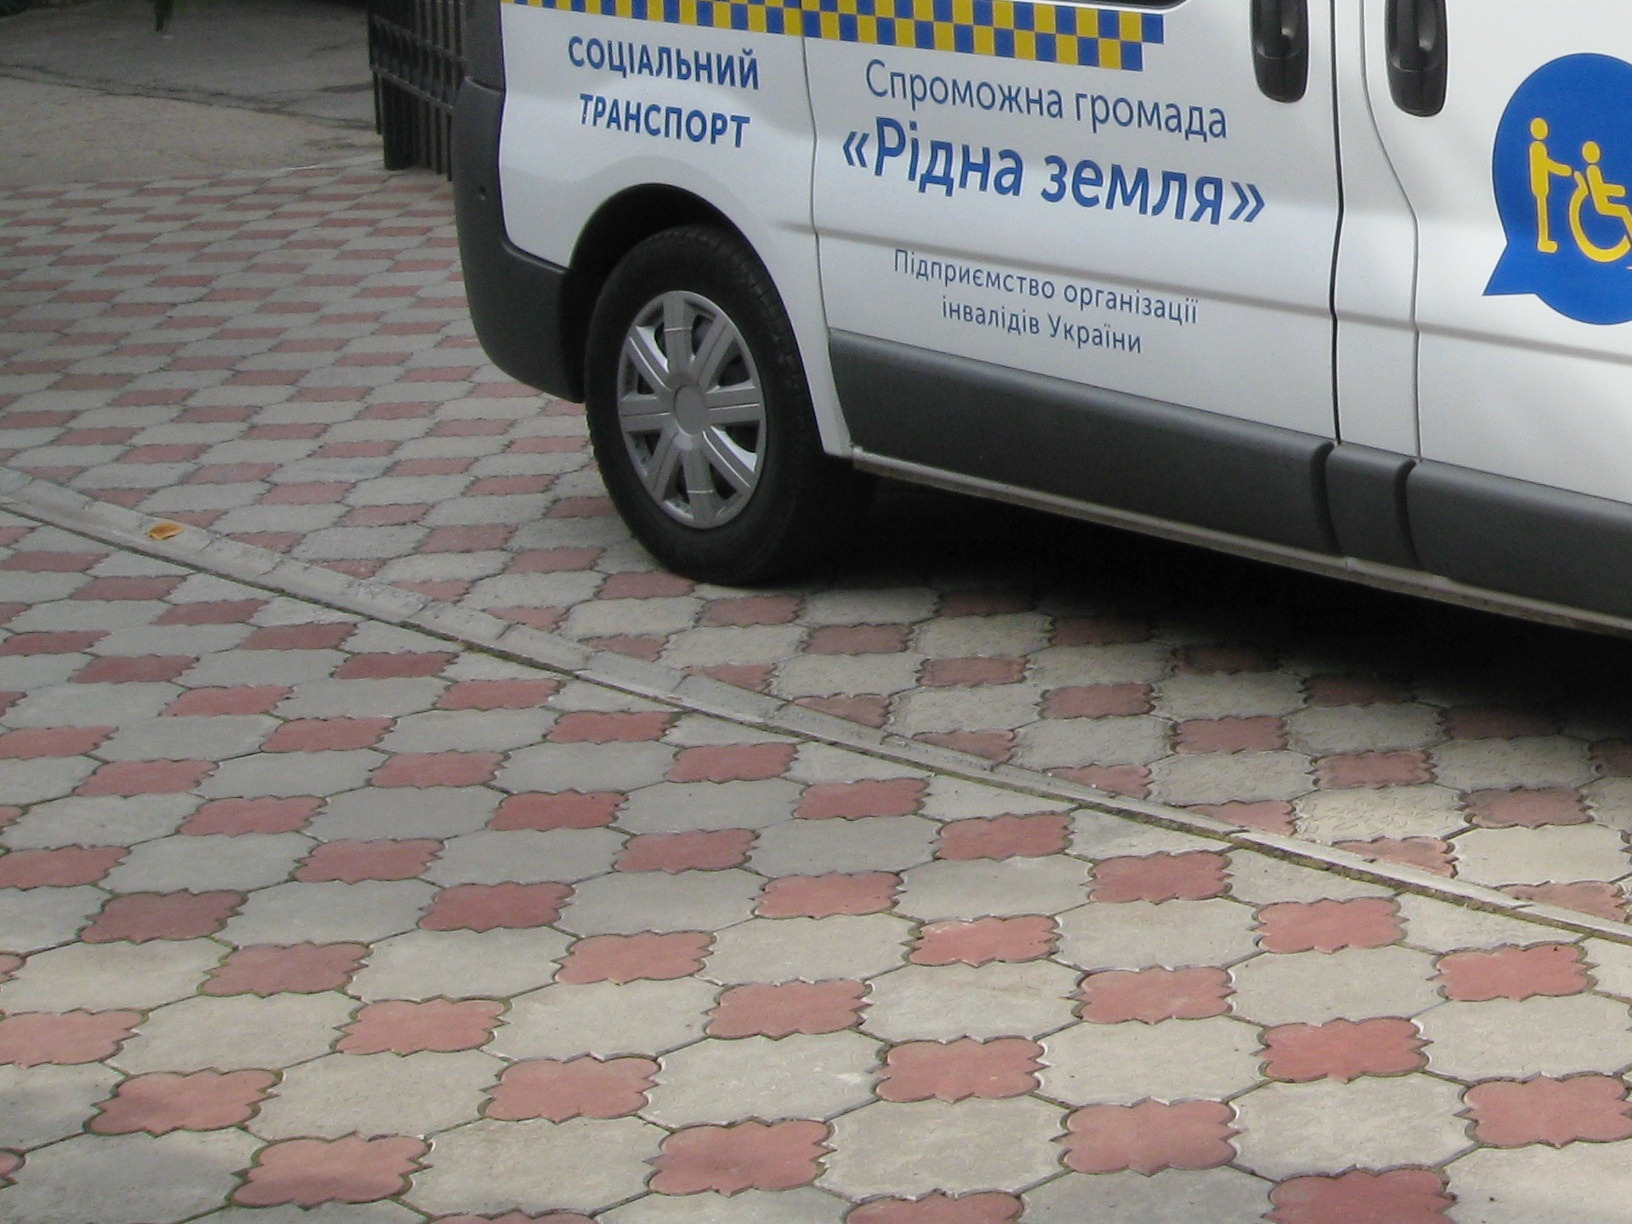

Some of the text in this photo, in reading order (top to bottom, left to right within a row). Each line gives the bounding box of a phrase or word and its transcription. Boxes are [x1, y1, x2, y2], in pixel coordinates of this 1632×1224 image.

[568, 35, 760, 90] СОЦІАЛЬНИЙ
[579, 92, 751, 149] ТРАНСПОРТ
[865, 58, 1228, 143] Спроможна громада
[842, 115, 1267, 226] «Рідна земля»
[893, 248, 1199, 326] Підприємство організації
[941, 294, 1143, 354] інвалідів України
